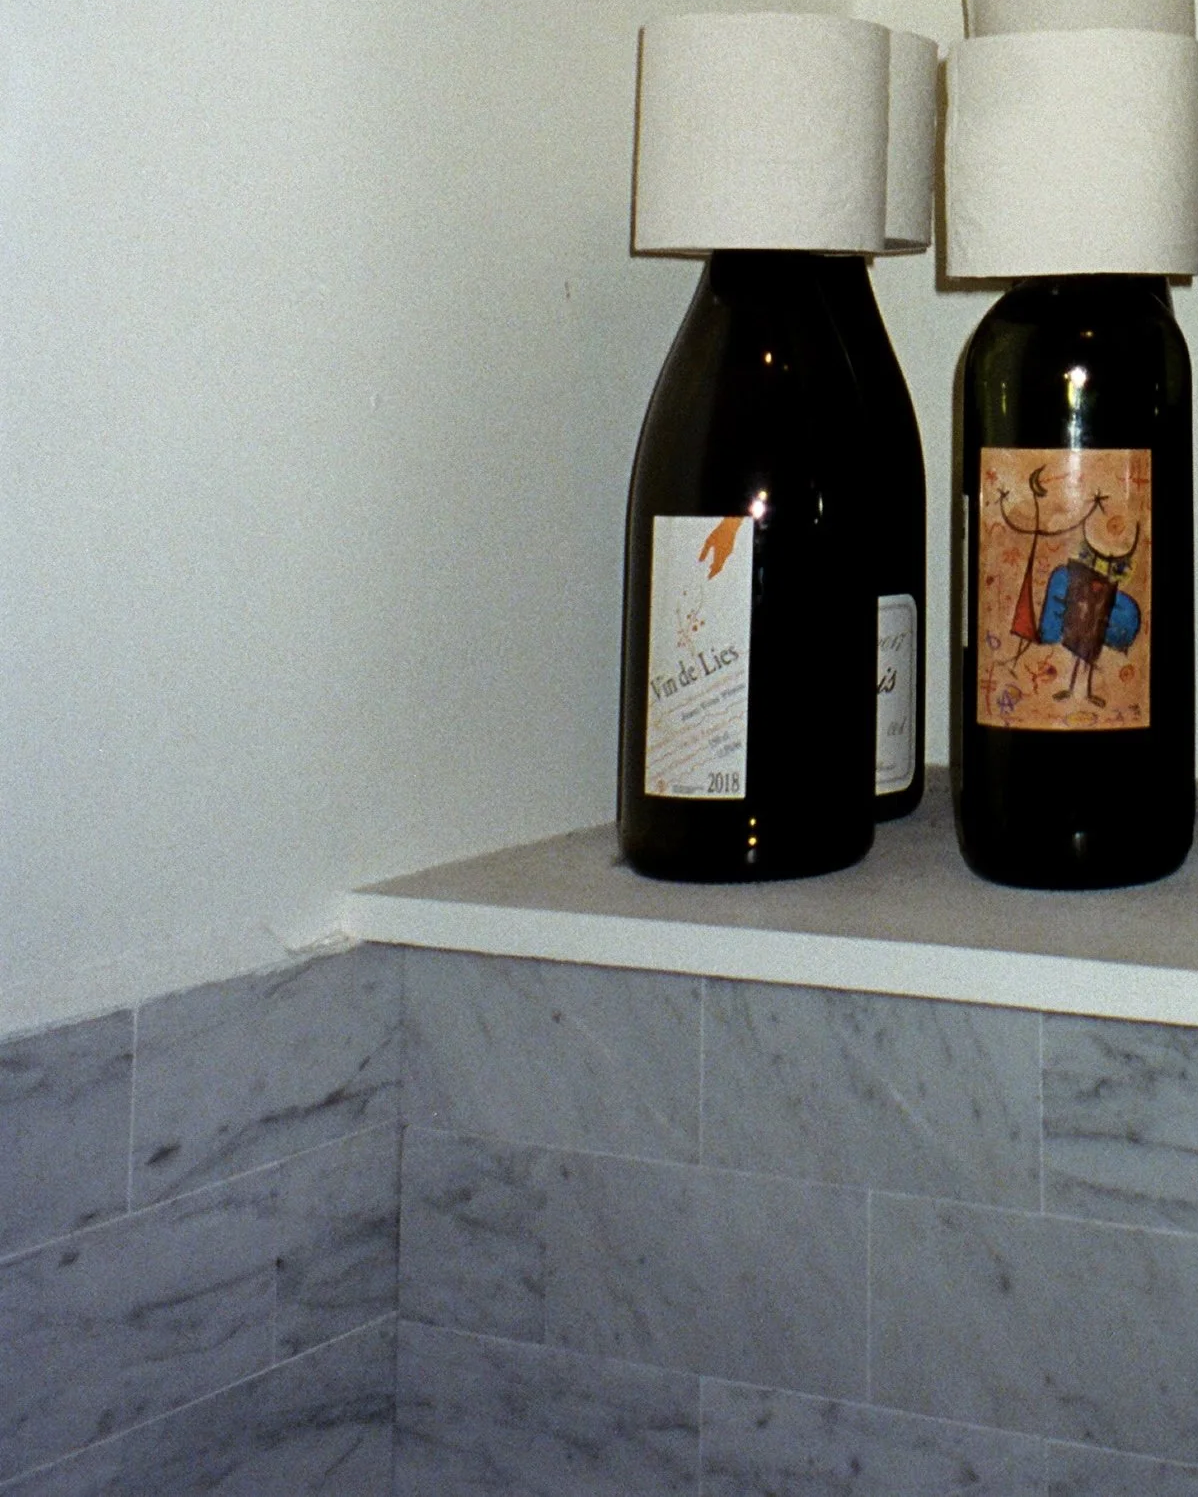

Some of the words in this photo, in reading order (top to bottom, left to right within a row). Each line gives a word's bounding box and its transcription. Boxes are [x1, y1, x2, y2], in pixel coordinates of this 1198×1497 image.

[679, 660, 697, 687] de
[698, 645, 739, 677] Lies
[707, 772, 740, 794] 2018
